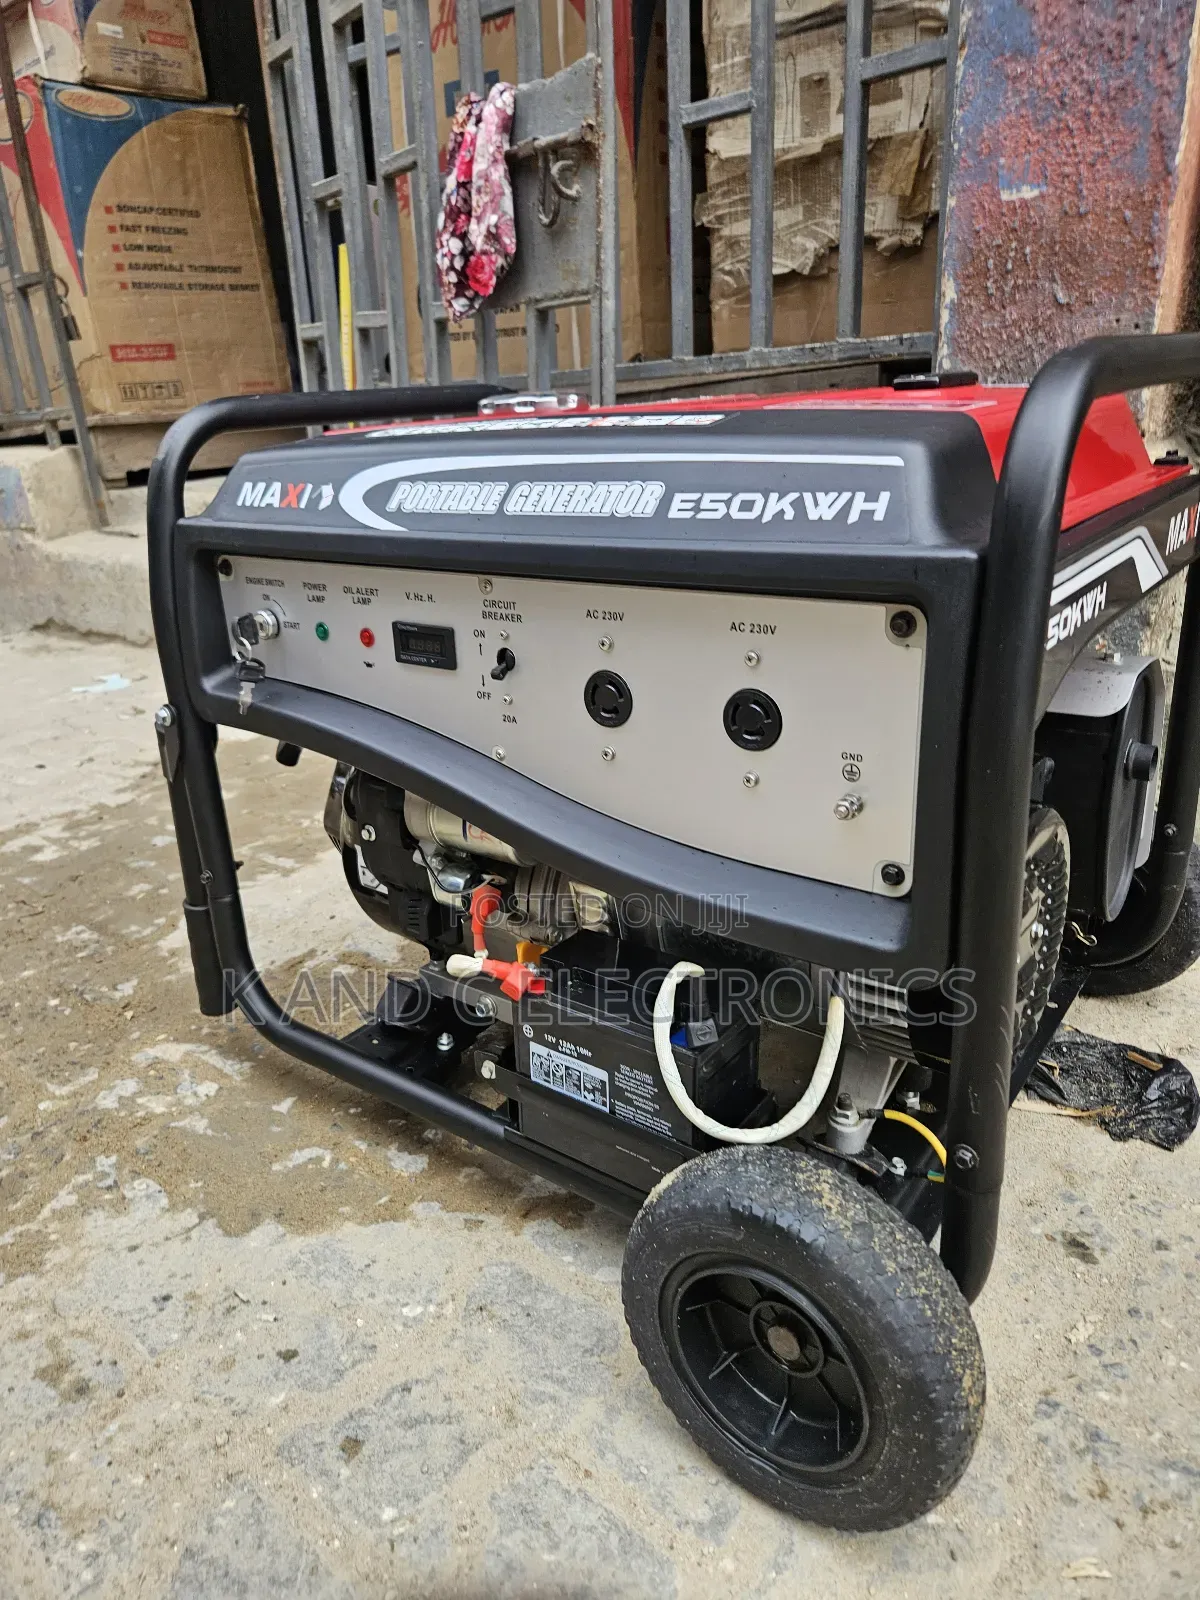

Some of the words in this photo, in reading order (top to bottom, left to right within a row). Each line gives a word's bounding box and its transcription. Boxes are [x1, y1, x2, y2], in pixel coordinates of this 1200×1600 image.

[120, 224, 142, 233] FAST
[144, 225, 188, 236] FREEZING
[123, 243, 144, 252] LOW
[146, 244, 172, 253] NOISE
[128, 262, 184, 273] ADJUSTABLE
[187, 264, 242, 274] THERMOSTAT
[131, 281, 184, 291] REMOVABLE
[187, 282, 226, 291] STORAGE
[228, 283, 260, 292] BASKET
[236, 481, 313, 510] MAXI
[385, 480, 510, 515] PORTABLE
[503, 480, 666, 518] GENERATOR
[667, 491, 891, 525] E50KWH
[245, 576, 265, 586] ENGINE
[265, 578, 285, 588] SWITCH
[302, 581, 327, 592] POWER
[262, 593, 271, 601] ON
[343, 585, 356, 595] OIL
[356, 587, 379, 597] ALERT
[306, 594, 326, 604] LAMP
[352, 596, 372, 606] LAMP
[483, 599, 517, 611] CIRCUIT
[482, 610, 523, 623] BREAKER
[586, 609, 599, 620] AC
[602, 609, 625, 622] 230V
[283, 621, 300, 631] START
[729, 621, 746, 633] AC
[748, 622, 778, 636] 230V
[473, 629, 486, 639] ON
[476, 691, 492, 701] OFF
[502, 714, 518, 724] 20A
[841, 751, 864, 763] GND
